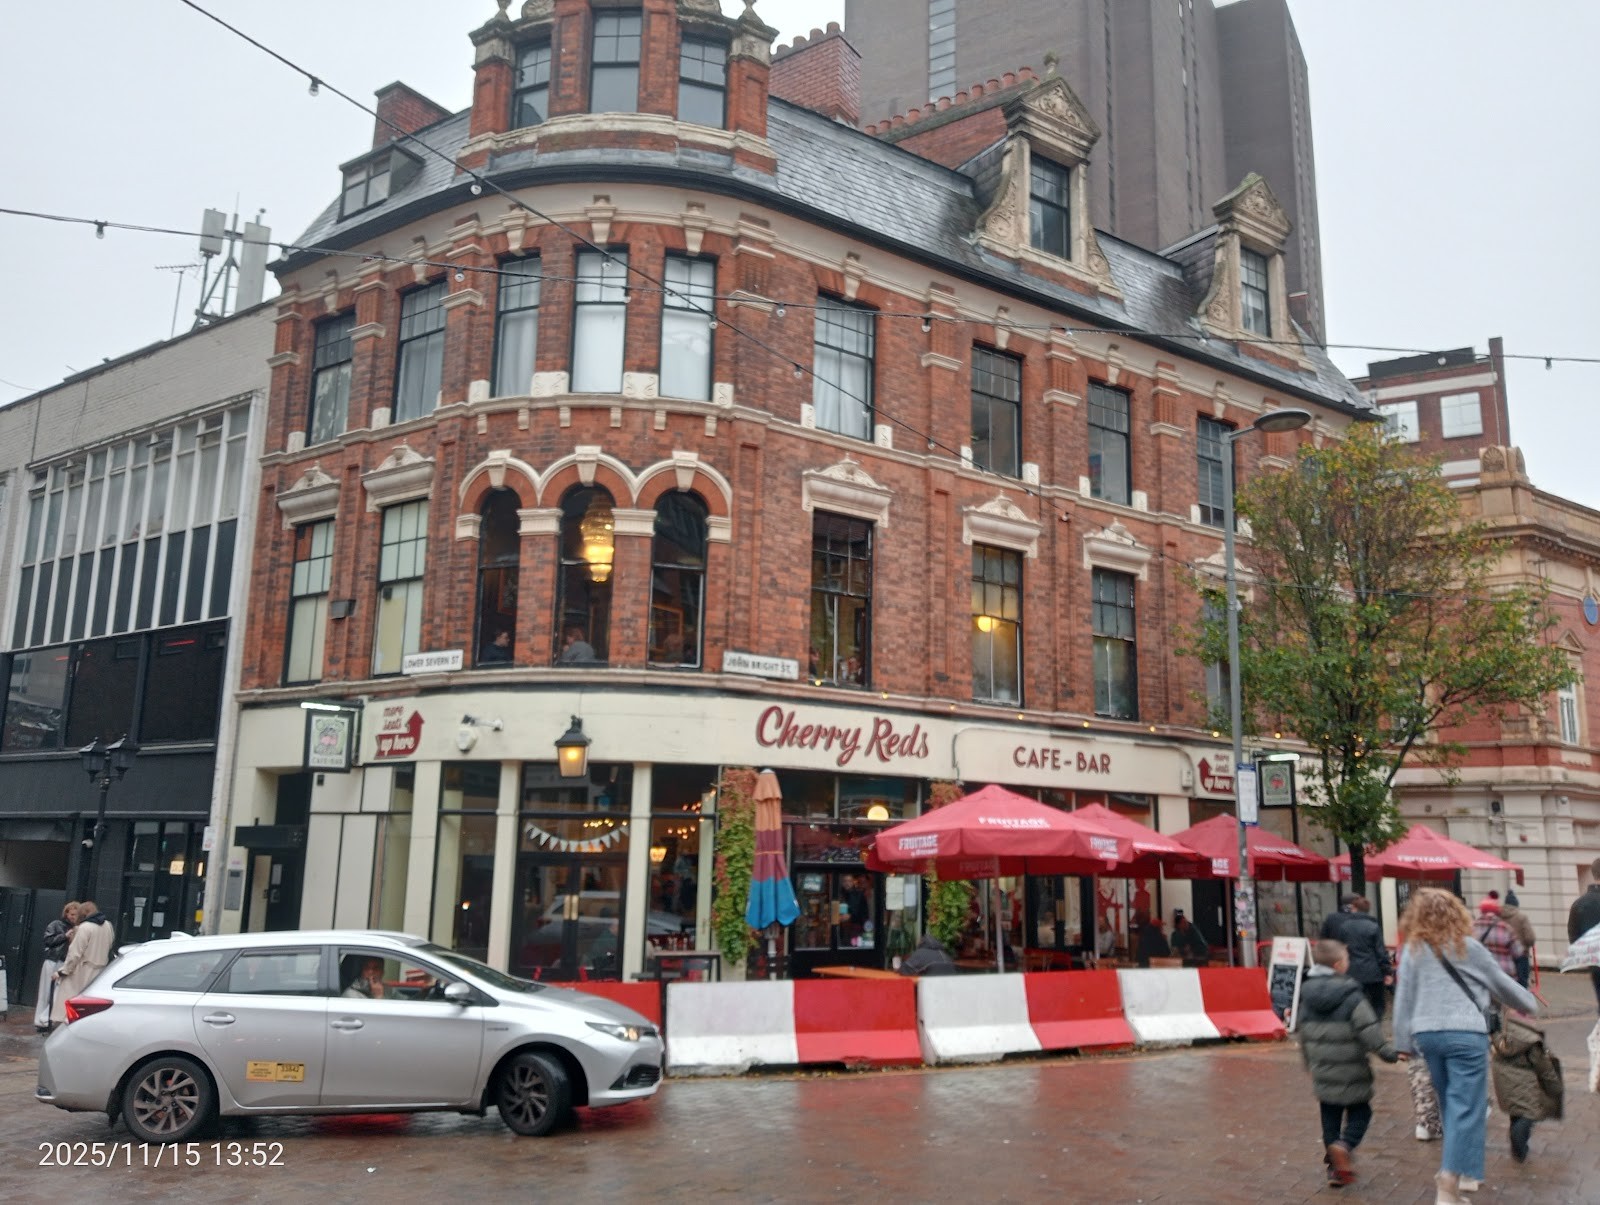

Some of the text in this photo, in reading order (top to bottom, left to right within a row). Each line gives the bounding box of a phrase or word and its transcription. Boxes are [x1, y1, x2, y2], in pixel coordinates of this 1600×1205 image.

[756, 705, 929, 767] Cherry Reds
[899, 835, 938, 850] FRUITAGE
